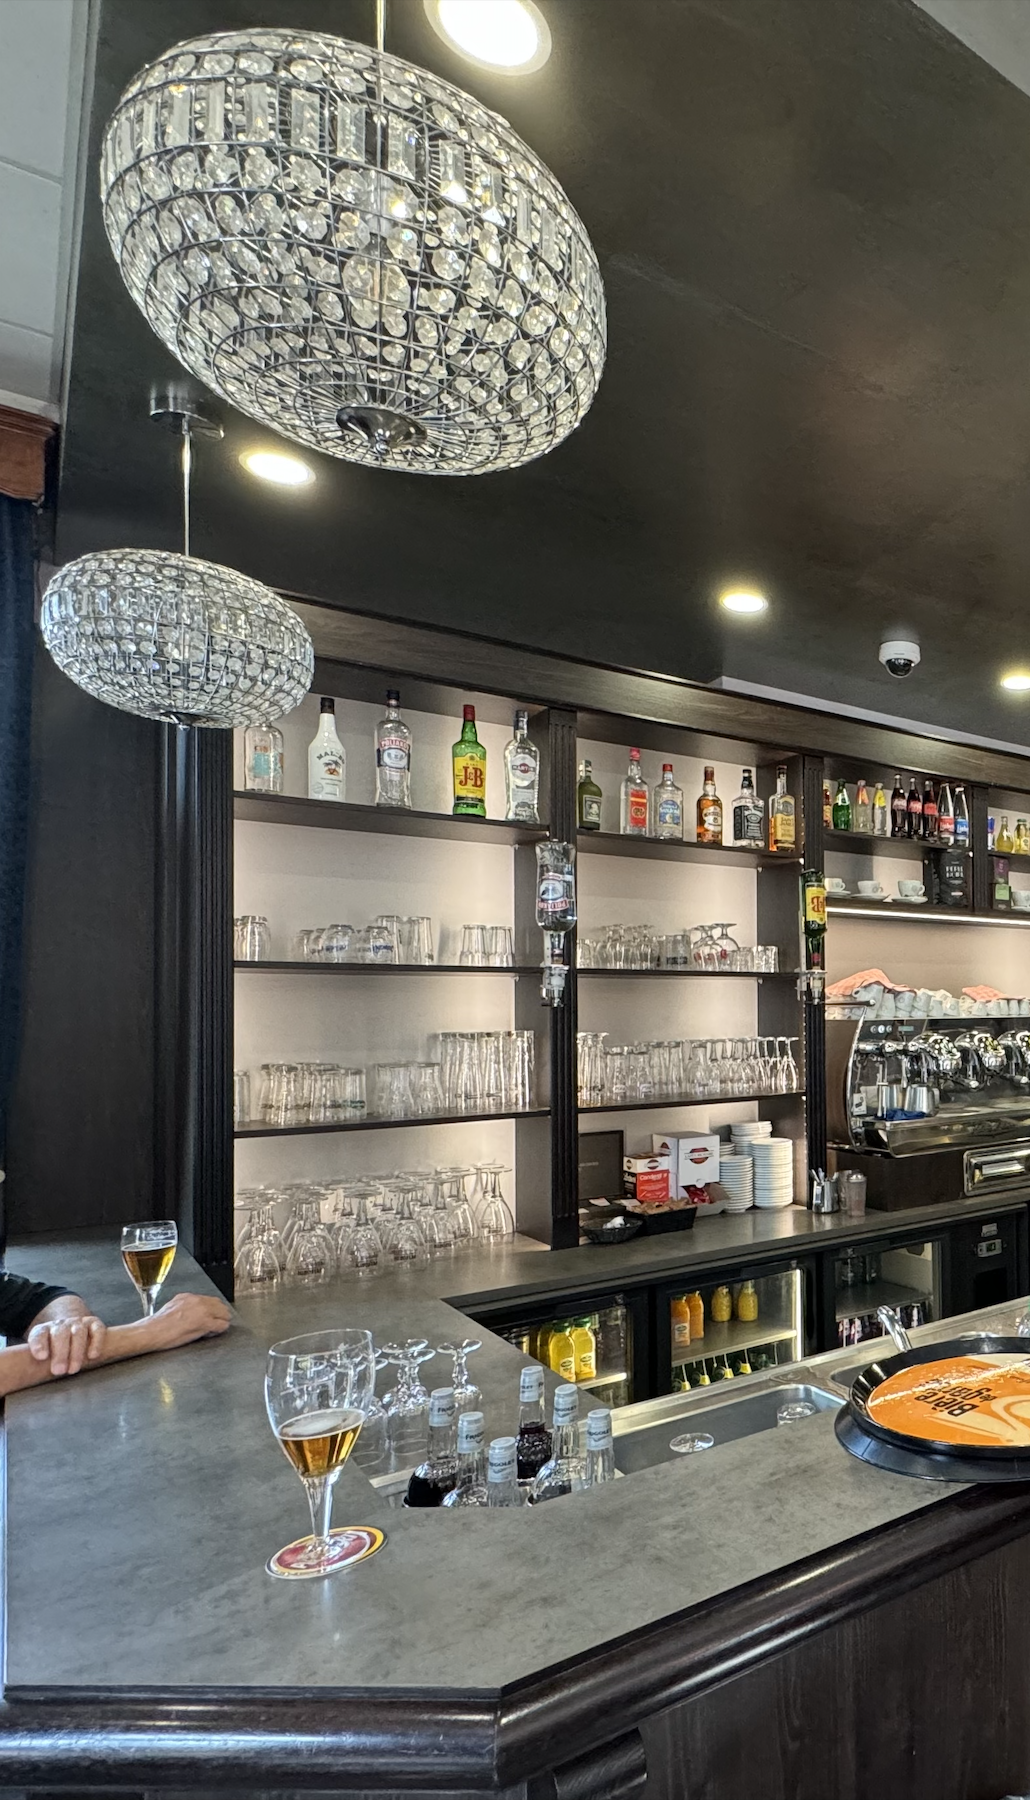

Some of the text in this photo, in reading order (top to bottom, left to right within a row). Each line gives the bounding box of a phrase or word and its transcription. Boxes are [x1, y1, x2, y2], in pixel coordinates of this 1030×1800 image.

[381, 738, 408, 749] POLIAKO
[459, 766, 484, 788] J&B
[538, 900, 567, 909] POLIAKO
[914, 1390, 980, 1417] Bière
